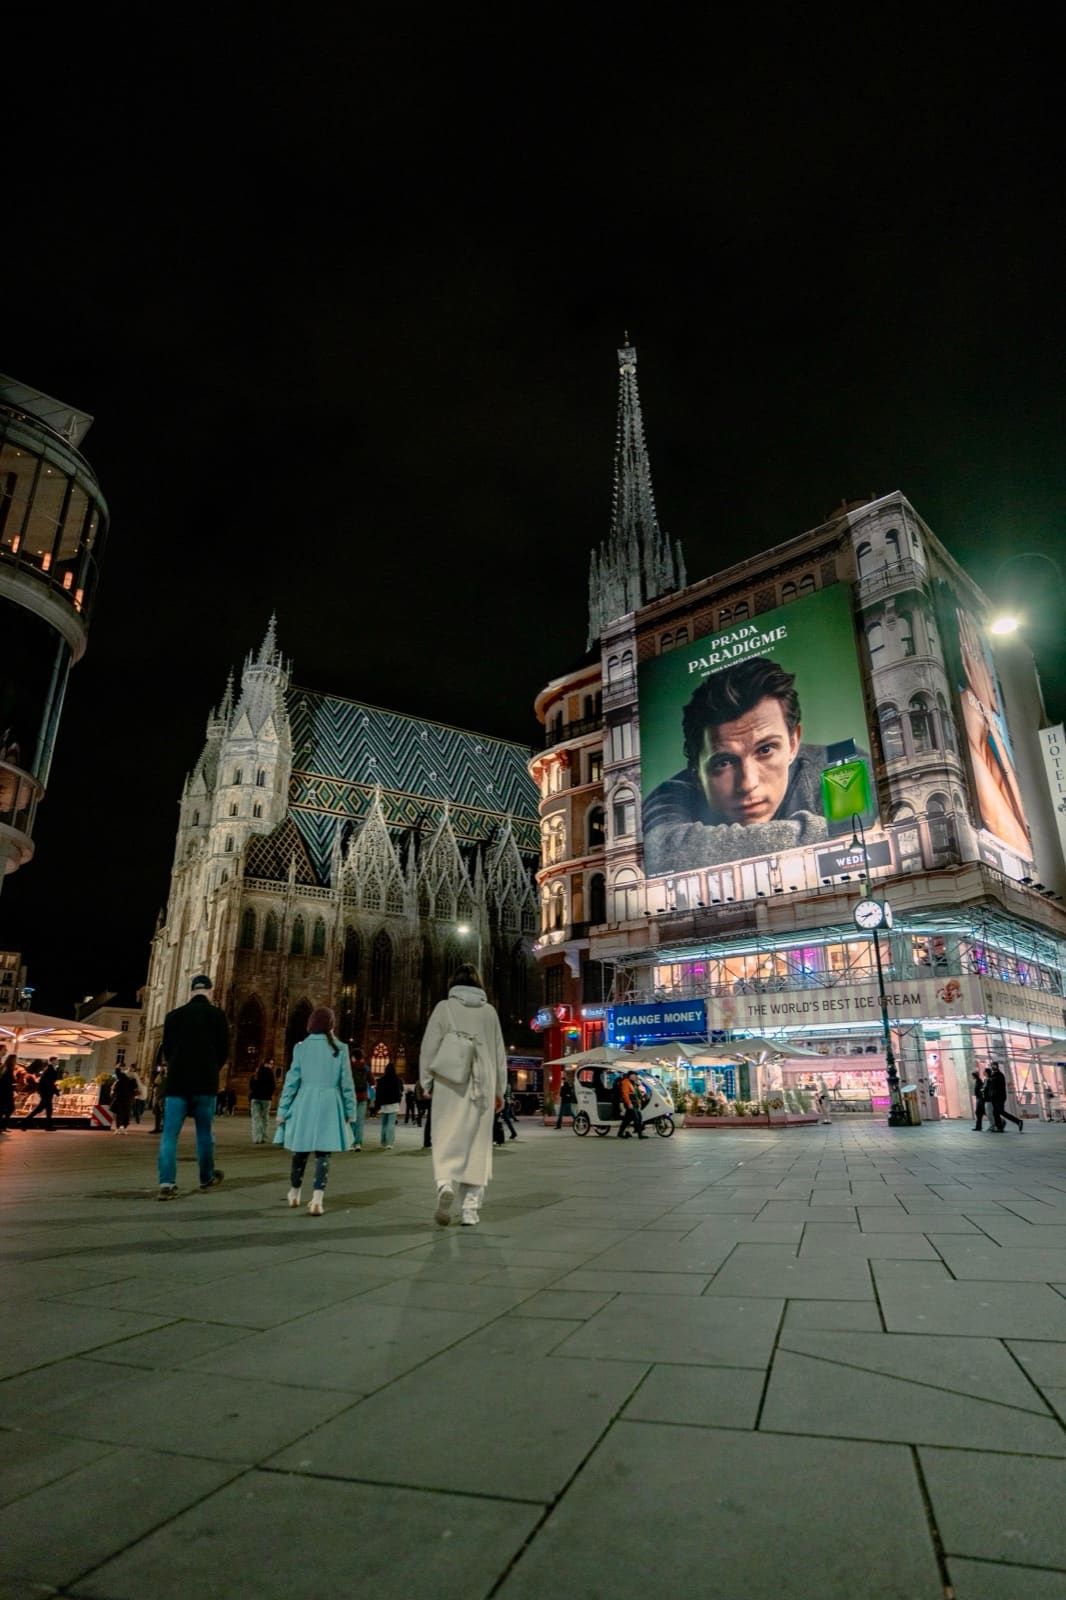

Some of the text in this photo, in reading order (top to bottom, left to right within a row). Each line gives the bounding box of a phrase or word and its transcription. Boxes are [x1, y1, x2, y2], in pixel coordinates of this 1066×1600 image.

[687, 625, 788, 674] PARADIGME
[711, 625, 758, 650] PRADA
[1047, 733, 1066, 793] HOTEL
[616, 1014, 661, 1026] CHANGE
[663, 1011, 702, 1024] MONEY
[748, 1005, 767, 1016] THE
[770, 1001, 819, 1014] WORLD'S
[823, 999, 850, 1011] BEST
[855, 996, 874, 1009] ICE
